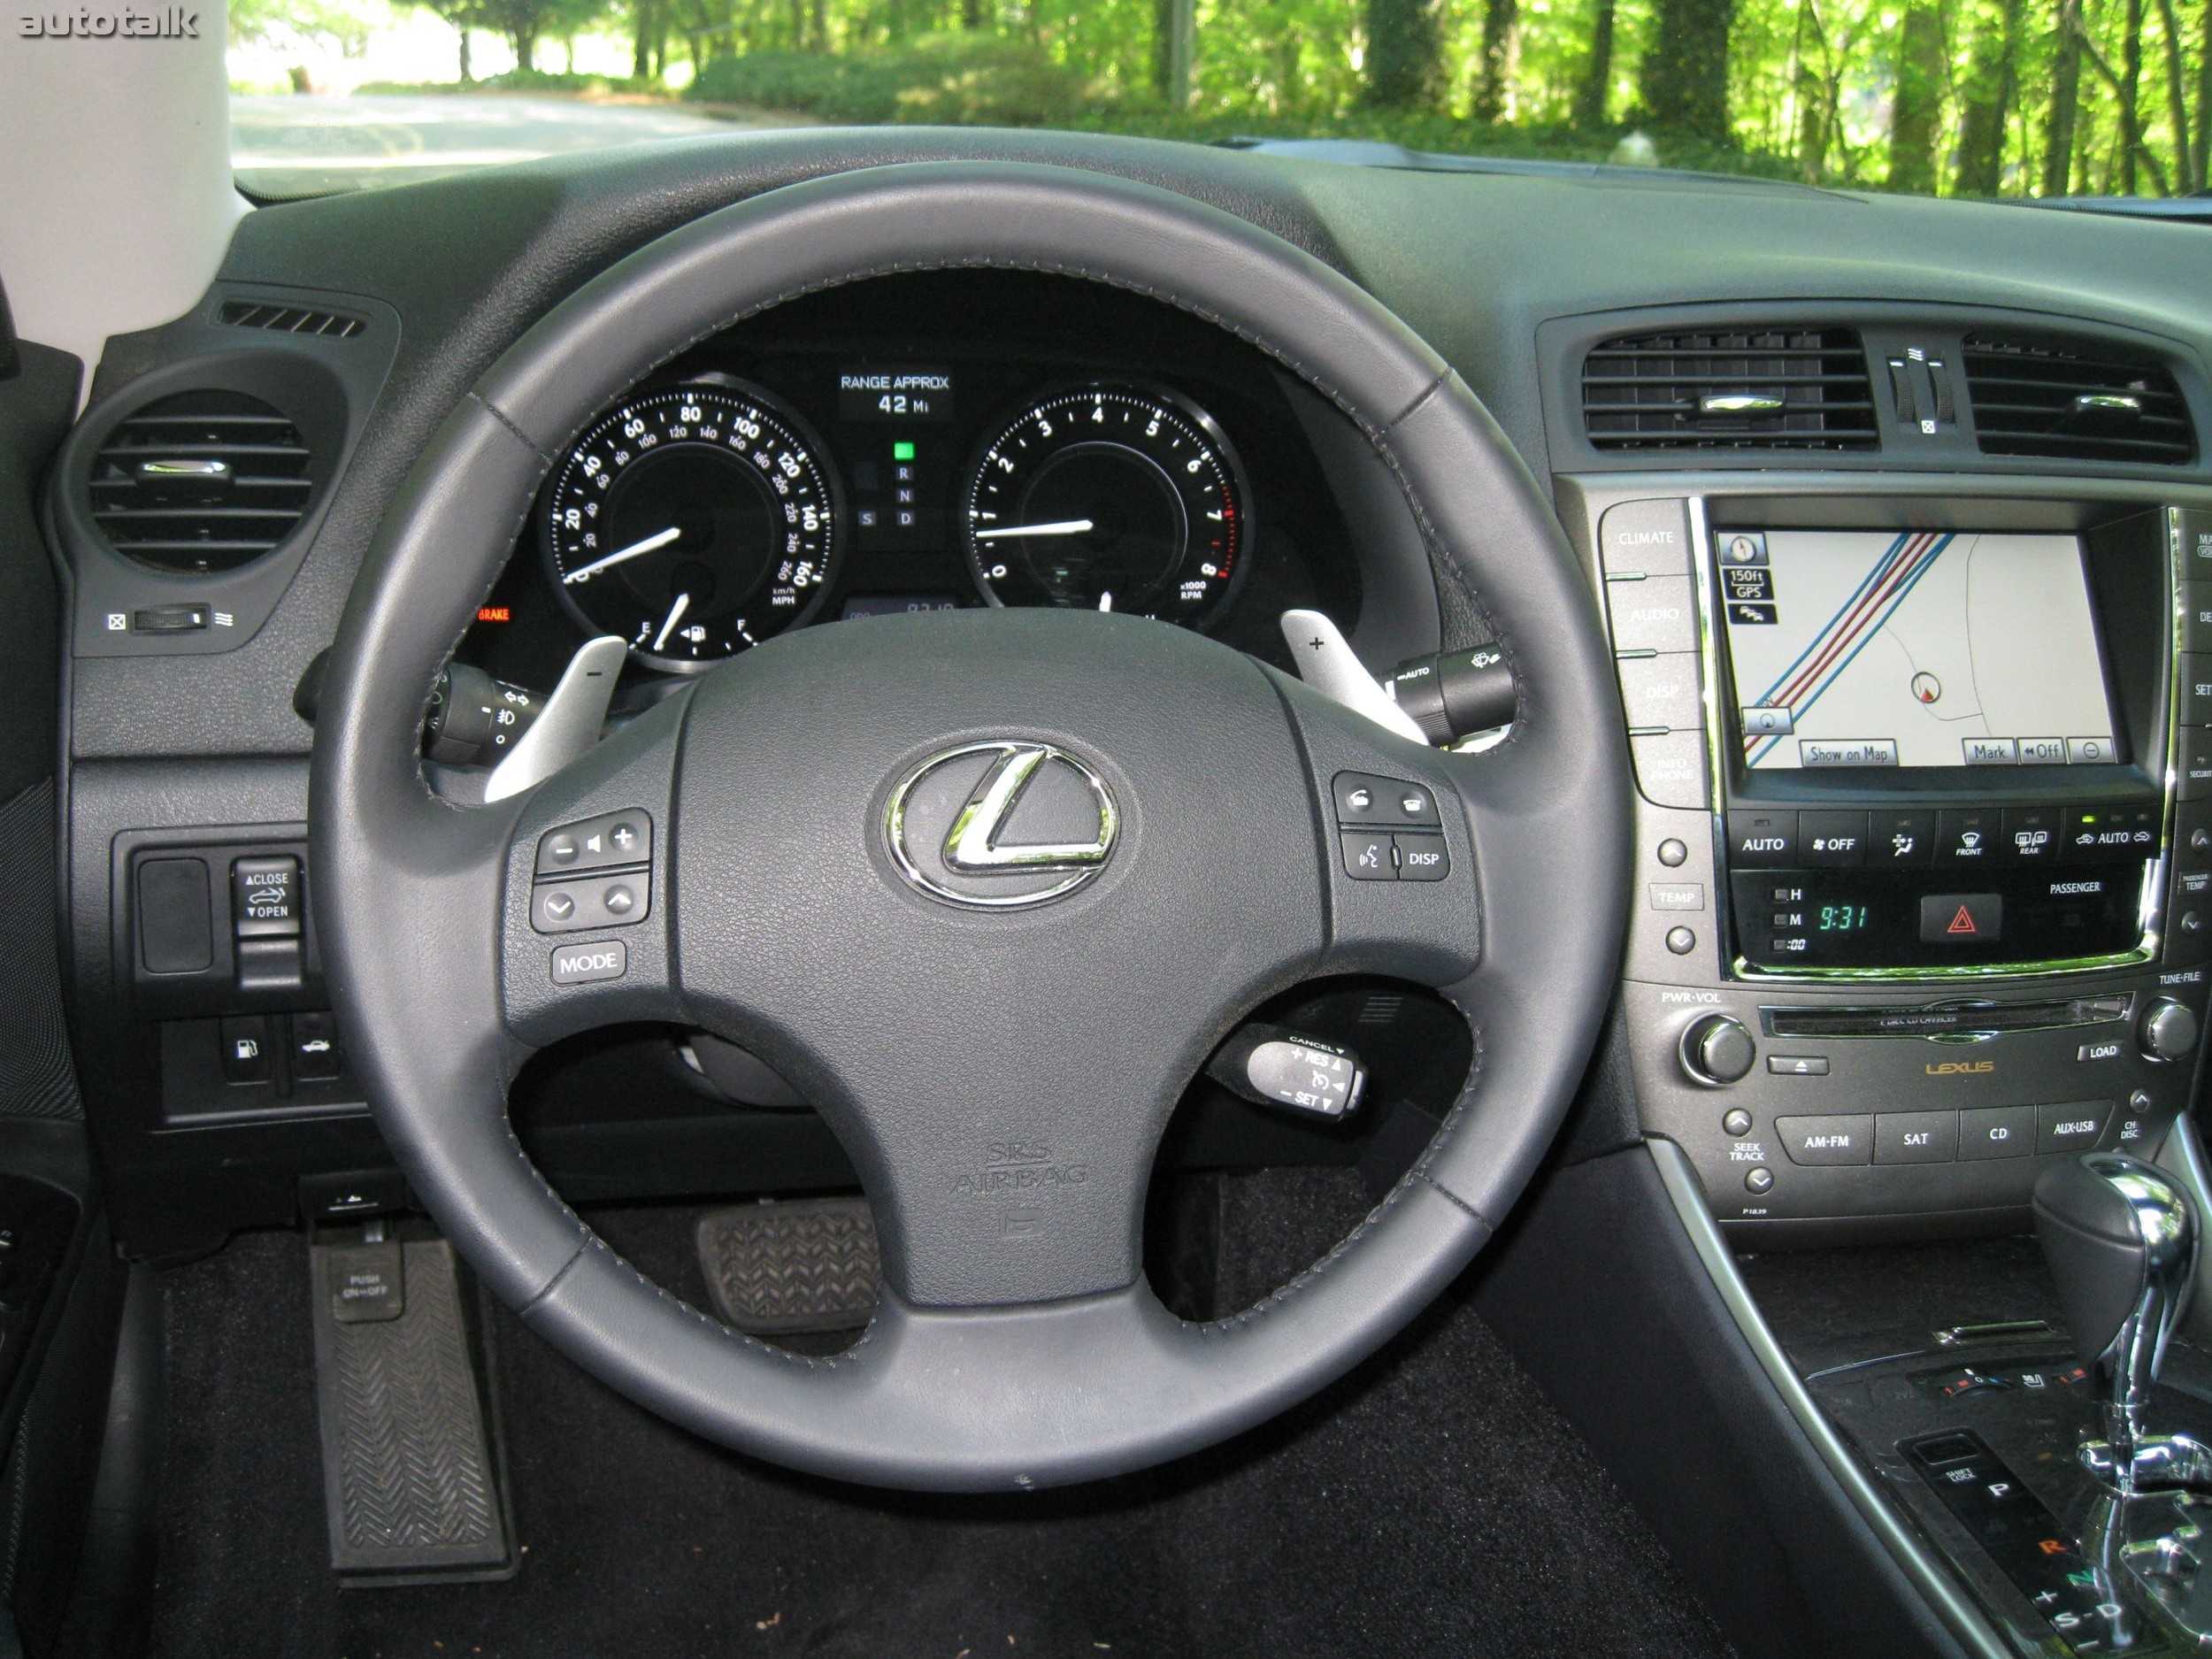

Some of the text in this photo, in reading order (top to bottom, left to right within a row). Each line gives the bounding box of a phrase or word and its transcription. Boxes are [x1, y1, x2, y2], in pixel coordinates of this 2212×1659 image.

[841, 376, 949, 389] RANGE APPROX
[879, 396, 907, 413] 42
[680, 406, 702, 423] 80
[1091, 407, 1104, 423] 4
[624, 419, 645, 439] 60
[669, 426, 688, 439] 120
[699, 426, 718, 440] 140
[733, 417, 759, 440] 100
[1038, 421, 1053, 437] 3
[1145, 421, 1160, 437] 5
[638, 434, 657, 449] 100
[727, 435, 747, 450] 160
[615, 450, 630, 465] 80
[752, 451, 771, 470] 180
[582, 455, 603, 478] 40
[778, 452, 800, 478] 120
[998, 457, 1015, 473] 2
[1187, 459, 1202, 473] 6
[898, 466, 910, 480] R
[597, 473, 611, 489] 60
[772, 474, 789, 495] 200
[900, 490, 910, 503] N
[585, 503, 598, 518] 40
[785, 503, 797, 523] 220
[801, 503, 818, 531] 140
[981, 511, 997, 521] 1
[1206, 509, 1224, 521] 7
[565, 509, 581, 530] 20
[862, 512, 872, 525] S
[901, 512, 911, 525] D
[585, 533, 597, 548] 20
[786, 533, 799, 553] 240
[1618, 531, 1675, 545] CLIMATE
[778, 560, 793, 581] 260
[793, 561, 813, 587] 160
[991, 565, 1008, 579] 0
[1201, 563, 1217, 577] 8
[1730, 569, 1764, 582] 150ft
[772, 587, 795, 595] km/h
[1179, 580, 1207, 591] x1000
[1736, 587, 1763, 598] GPS
[772, 595, 795, 605] MPH
[1180, 590, 1202, 601] RPM
[478, 608, 510, 621] BRAKE
[1630, 608, 1679, 621] AUDIO
[641, 621, 651, 634] E
[737, 619, 746, 631] F
[1405, 666, 1430, 680] AUTO
[1646, 685, 1679, 699] DISP
[1810, 747, 1887, 764] Show on Map
[1974, 744, 2006, 760] Mark
[2036, 743, 2059, 759] Off
[1655, 758, 1687, 769] INFO
[1649, 769, 1694, 780] PHONE
[1742, 838, 1785, 851] AUTO
[1828, 838, 1855, 851] OFF
[2098, 833, 2129, 844] AUTO
[1409, 853, 1440, 865] DISP
[1955, 848, 1982, 856] FRONT
[253, 872, 289, 885] CLOSE
[2049, 881, 2101, 895] PASSENGER
[2186, 881, 2206, 891] TEMP
[1659, 892, 1695, 903] TEMP
[1790, 889, 1801, 901] H
[257, 905, 288, 918] OPEN
[1819, 906, 1866, 930] 9:31
[1789, 914, 1801, 926] M
[559, 952, 618, 974] MODE
[1289, 1036, 1335, 1053] CANCEL
[2090, 1045, 2117, 1058] LOAD
[1305, 1050, 1330, 1067] RES
[1925, 1061, 1994, 1075] LEXUS
[1294, 1091, 1320, 1107] SET
[2124, 1120, 2137, 1131] CH
[1903, 1133, 1929, 1146] SAT
[1990, 1127, 2008, 1141] CD
[2120, 1129, 2139, 1140] DISC
[987, 1141, 1052, 1162] SRS
[1733, 1142, 1761, 1152] SEEK
[1729, 1151, 1765, 1162] TRACK
[949, 1164, 1089, 1195] AIRBAG
[350, 1274, 380, 1285] PUSH
[1946, 1467, 1972, 1478] SHIFT
[1948, 1472, 1976, 1482] LOCK
[1988, 1483, 2010, 1497] P
[2039, 1540, 2067, 1555] R
[2096, 1603, 2122, 1618] D
[2055, 1612, 2080, 1628] S
